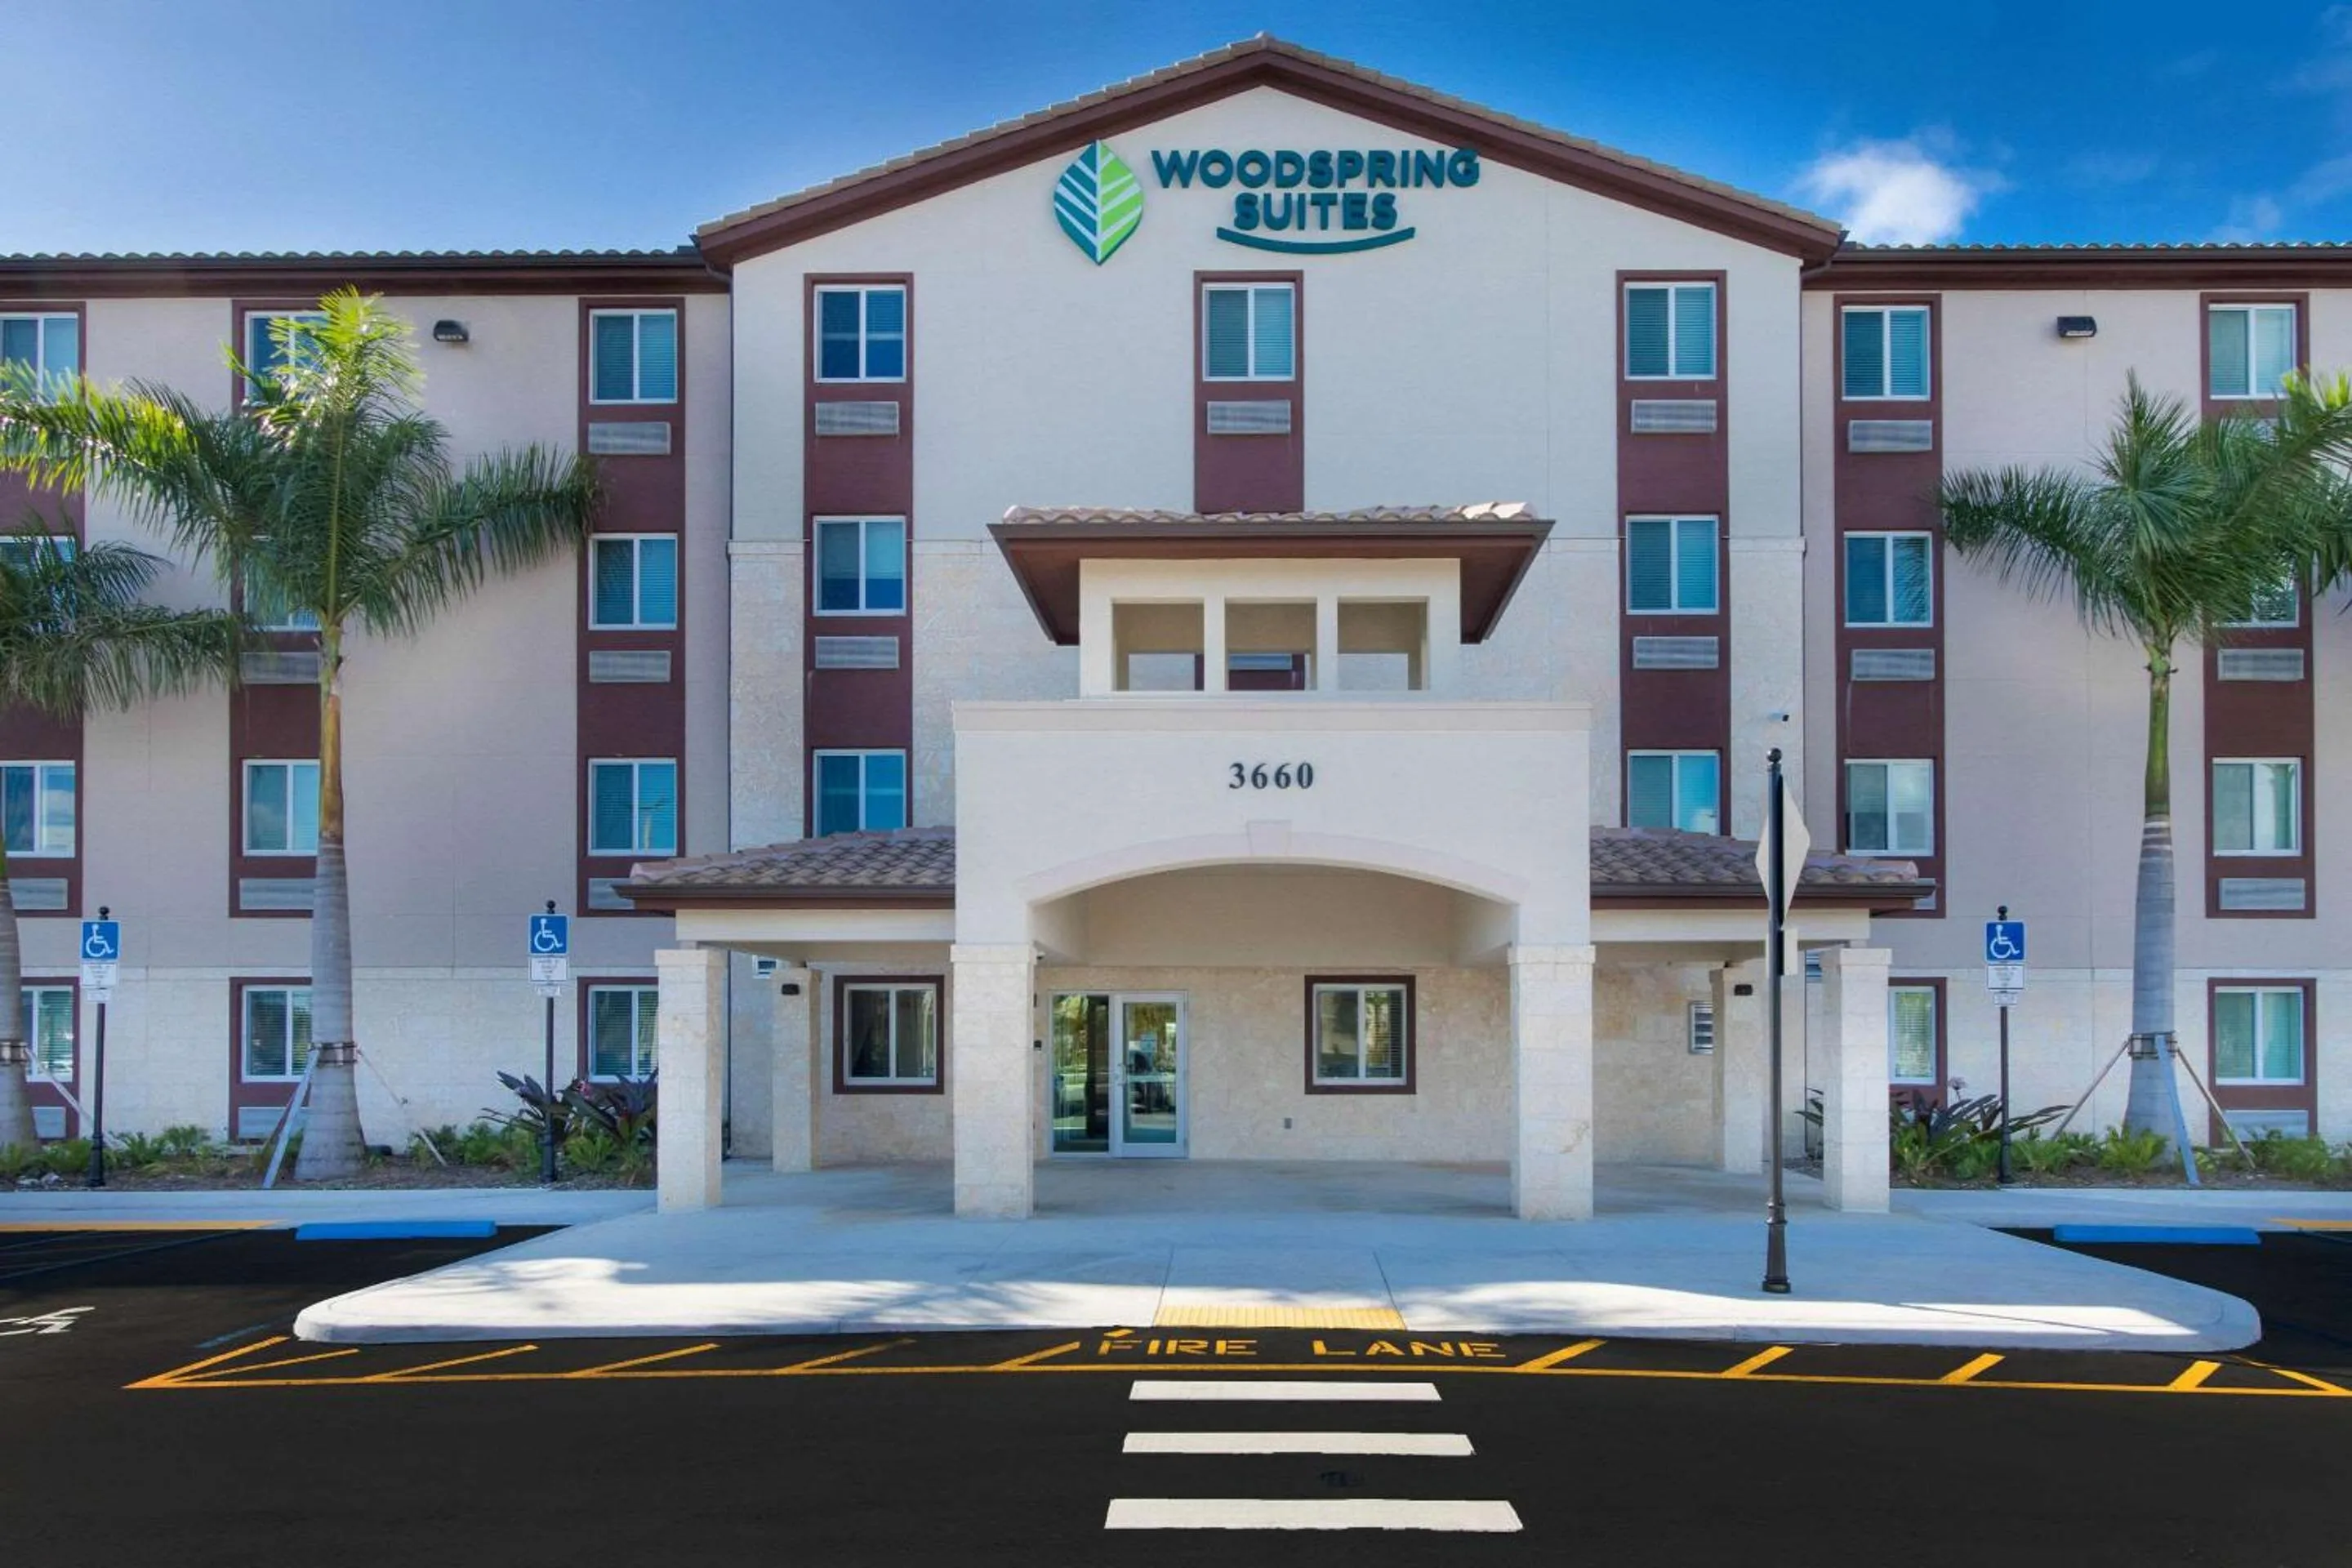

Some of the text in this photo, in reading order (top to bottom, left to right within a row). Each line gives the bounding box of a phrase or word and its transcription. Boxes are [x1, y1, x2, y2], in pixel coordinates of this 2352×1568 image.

[1151, 148, 1481, 189] WOODSPRING
[1233, 191, 1398, 231] SUITES
[1228, 761, 1314, 790] 3660
[1098, 1339, 1507, 1358] FIRE LANE
